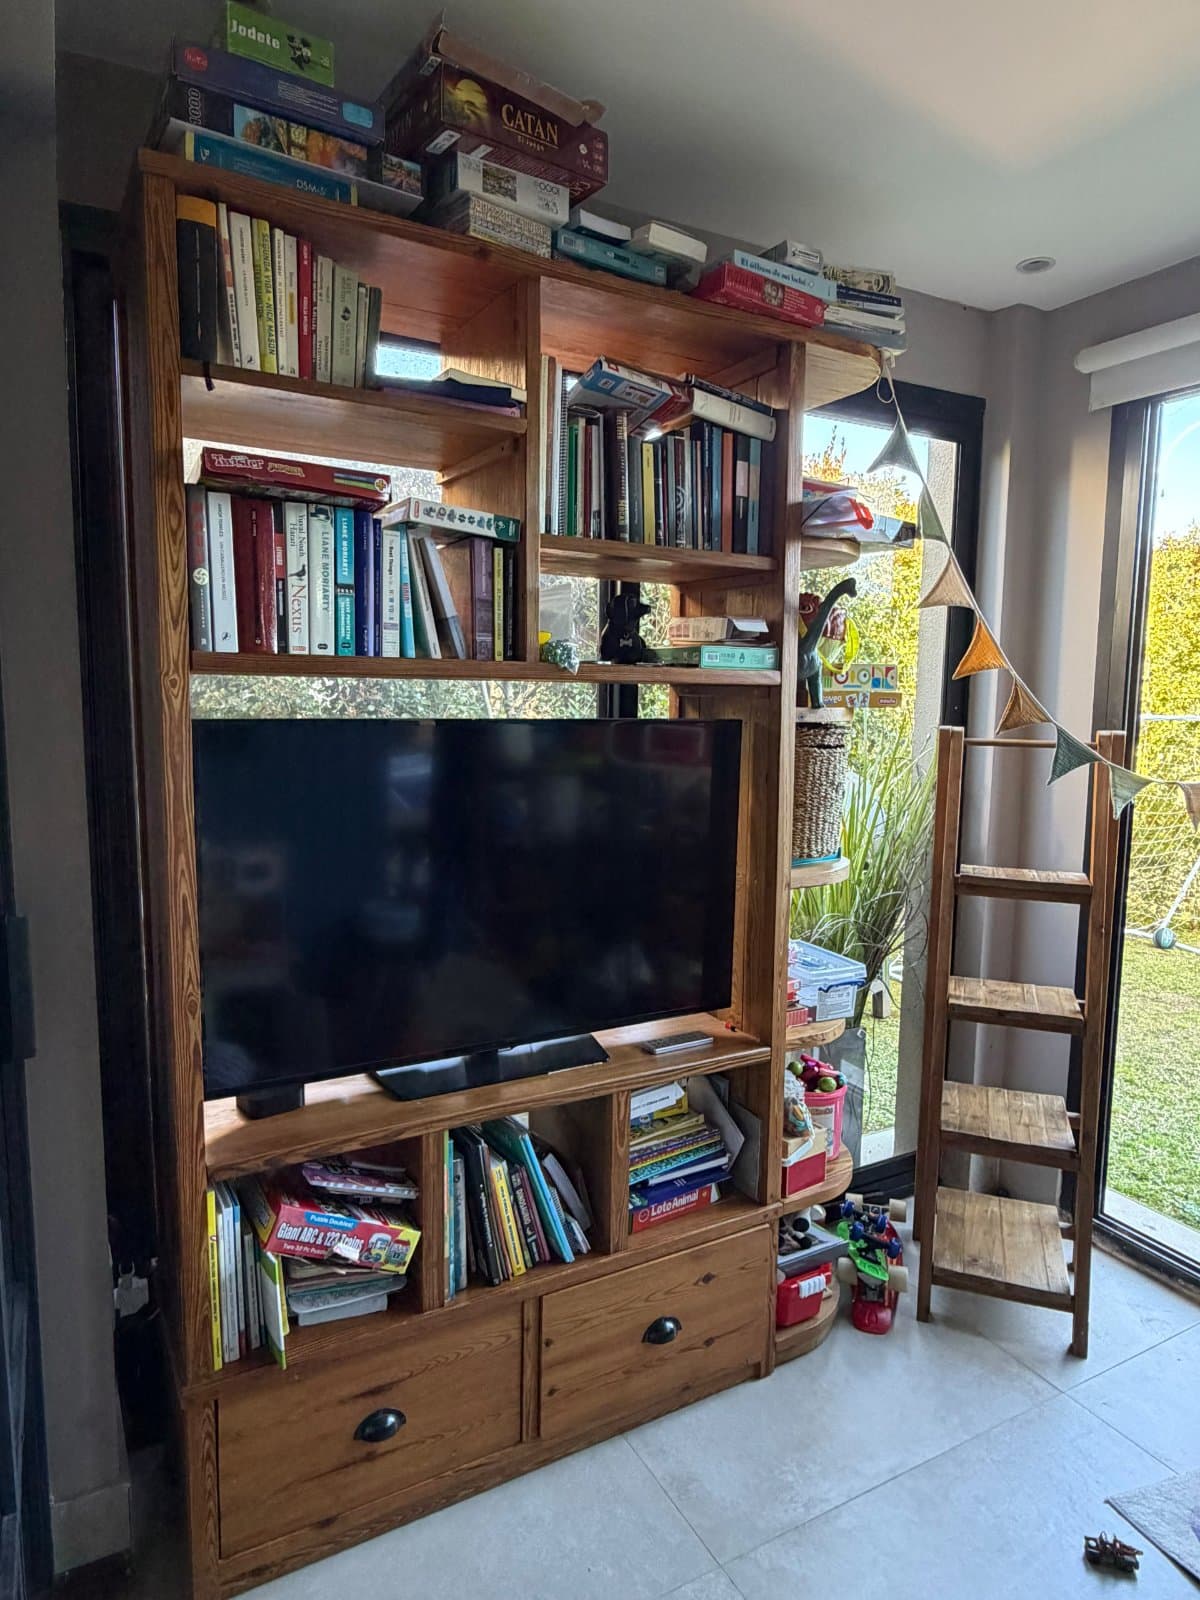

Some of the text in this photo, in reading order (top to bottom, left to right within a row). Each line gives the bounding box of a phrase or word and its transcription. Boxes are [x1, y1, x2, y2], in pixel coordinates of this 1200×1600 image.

[231, 19, 281, 49] Jodete
[501, 103, 559, 145] CATAN
[261, 232, 271, 273] SEGUNDA
[265, 302, 275, 322] NICK
[267, 324, 276, 356] MASON
[289, 522, 298, 547] Harari
[298, 514, 307, 557] Yuval Noah
[321, 531, 330, 613] LIANE MORIARTY
[291, 584, 307, 633] Nexus
[278, 1223, 301, 1241] Giant
[300, 1226, 317, 1244] ABC
[316, 1232, 323, 1244] &
[323, 1231, 340, 1247] 123
